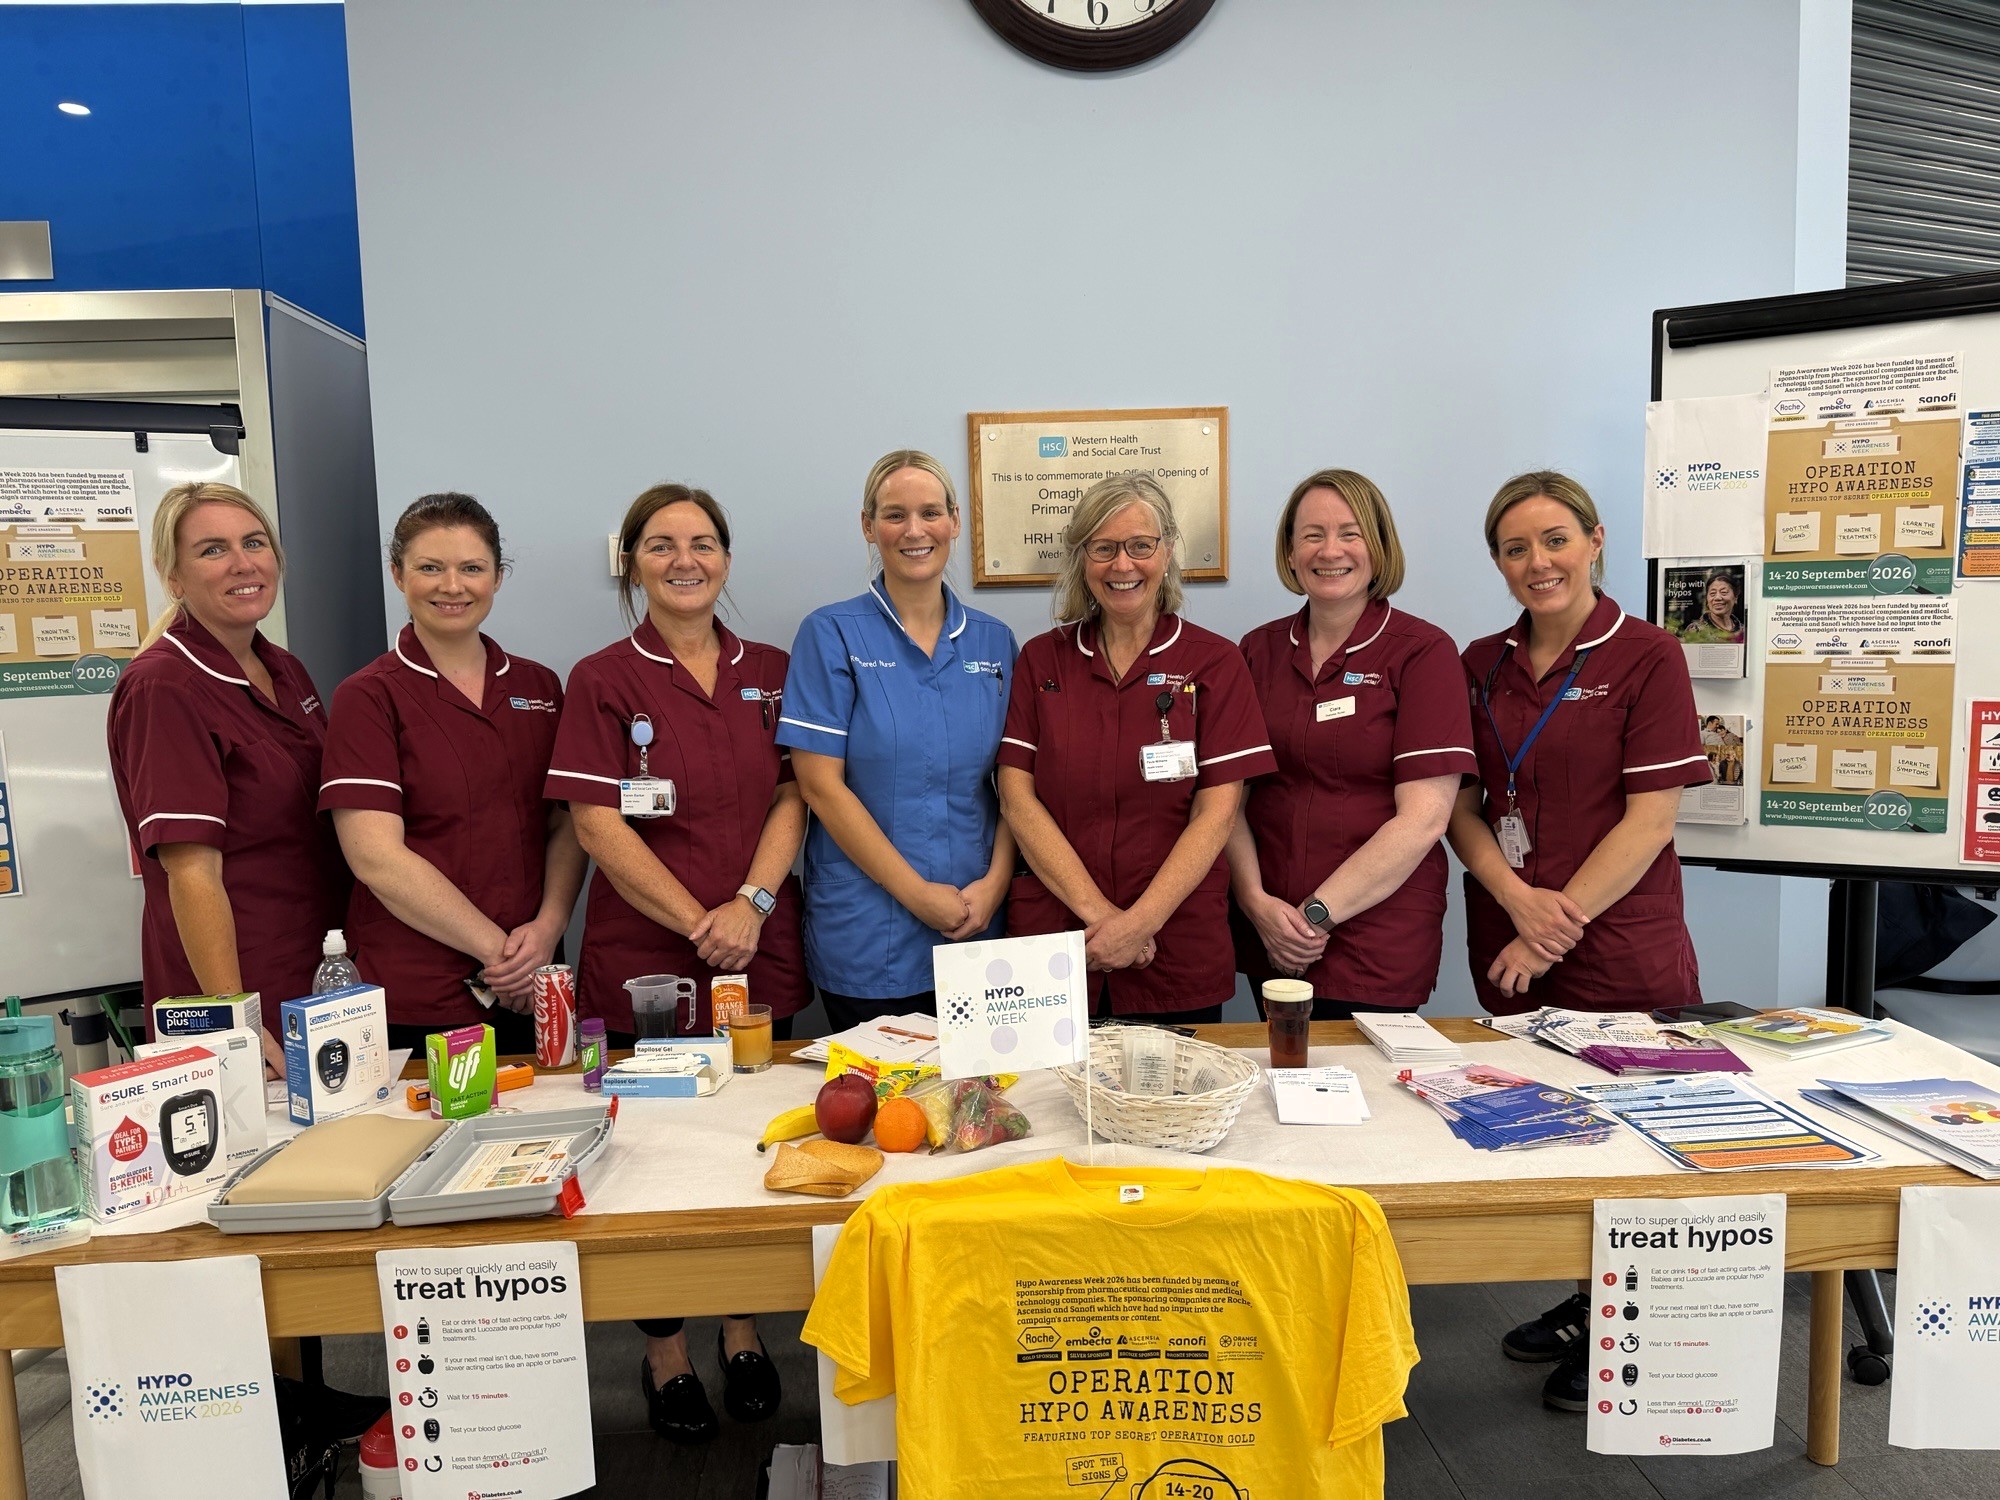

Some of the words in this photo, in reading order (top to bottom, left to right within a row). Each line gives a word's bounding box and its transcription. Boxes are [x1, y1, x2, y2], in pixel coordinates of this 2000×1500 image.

[1780, 403, 1800, 411] Roche
[1919, 393, 1956, 403] sanofi
[1072, 436, 1107, 445] Western
[1110, 435, 1138, 443] Health
[1042, 443, 1063, 452] HSC
[1073, 449, 1088, 457] and
[1092, 447, 1116, 456] Social
[1119, 447, 1138, 456] Care
[1141, 446, 1161, 455] Trust
[1687, 462, 1721, 472] HYPO
[1805, 460, 1916, 479] OPERATION
[992, 473, 1012, 482] This
[1014, 472, 1022, 482] is
[1025, 472, 1034, 481] to
[1037, 470, 1102, 481] commemorate
[1106, 470, 1120, 479] the
[1157, 467, 1197, 479] Opening
[1200, 467, 1209, 476] of
[1687, 469, 1760, 482] AWARENESS
[1687, 482, 1721, 491] WEEK
[1722, 480, 1747, 490] 2026
[1788, 482, 1829, 494] HYPO
[1835, 477, 1933, 492] AWARENESS
[1039, 487, 1083, 501] Omagh
[1790, 494, 1827, 502] FEATURING
[97, 507, 132, 515] sanofi
[1024, 533, 1052, 544] HRH
[1901, 528, 1934, 536] SYMPTOMS
[1769, 570, 1799, 580] 14-20
[1802, 569, 1867, 582] September
[1872, 567, 1912, 580] 2026
[26, 582, 123, 595] AWARENESS
[1668, 580, 1687, 590] Help
[1689, 579, 1706, 589] with
[1768, 583, 1868, 591] www.hypoawarenessweek.com
[1668, 588, 1692, 598] hypos
[1914, 638, 1951, 647] sanofi
[879, 660, 896, 668] Nurse
[3, 670, 71, 683] September
[77, 667, 116, 680] 2026
[1802, 700, 1911, 714] OPERATION
[1785, 716, 1825, 727] HYPO
[1831, 717, 1928, 729] AWARENESS
[1767, 800, 1796, 809] 14-20
[1799, 801, 1863, 813] September
[1868, 804, 1907, 816] 2026
[1765, 813, 1864, 823] www.hypoawarenessweek.com
[985, 986, 1024, 1000] HYPO
[343, 1003, 372, 1017] Nexus
[715, 1001, 743, 1010] ORANGE
[986, 994, 1067, 1013] AWARENESS
[166, 1010, 208, 1018] Contour
[987, 1012, 1028, 1026] WEEK
[166, 1018, 189, 1029] plus
[190, 1018, 210, 1028] BLUE
[152, 1074, 188, 1091] Smart
[192, 1068, 214, 1080] Duo
[450, 1095, 465, 1103] FAST
[466, 1090, 488, 1101] ACTING
[115, 1136, 136, 1148] TYPE
[115, 1143, 142, 1155] PATIENTS
[118, 1200, 140, 1210] NIPRO
[1610, 1215, 1633, 1225] how
[1635, 1215, 1646, 1225] to
[1648, 1216, 1678, 1226] super
[1681, 1214, 1715, 1226] quickly
[1717, 1213, 1736, 1223] and
[1739, 1212, 1766, 1223] easily
[1609, 1227, 1678, 1249] treat
[1688, 1226, 1773, 1252] hypos
[395, 1266, 418, 1276] how
[421, 1266, 431, 1275] to
[434, 1266, 463, 1277] super
[466, 1262, 502, 1276] quickly
[506, 1261, 525, 1272] and
[529, 1260, 557, 1271] easily
[394, 1277, 465, 1300] treat
[475, 1275, 566, 1302] hypos
[1016, 1280, 1037, 1288] Hypo
[1038, 1279, 1082, 1287] Awareness
[1143, 1276, 1160, 1284] been
[1192, 1277, 1201, 1286] by
[1016, 1287, 1064, 1298] sponsorship
[1088, 1286, 1150, 1295] pharmaceutical
[1212, 1287, 1242, 1296] medical
[1017, 1298, 1060, 1306] technology
[1062, 1296, 1106, 1305] companies.
[1124, 1296, 1167, 1304] sponsoring
[1169, 1296, 1211, 1304] companies
[1227, 1297, 1252, 1307] Roche,
[1017, 1306, 1051, 1315] Ascensia
[1070, 1305, 1095, 1313] Sanofi
[1143, 1304, 1158, 1312] had
[1017, 1316, 1061, 1325] campaign's
[1063, 1315, 1119, 1323] arrangements
[1025, 1333, 1054, 1344] Roche
[1066, 1336, 1111, 1346] embecta
[1169, 1336, 1206, 1346] sanofi
[137, 1373, 192, 1390] HYPO
[1049, 1369, 1234, 1395] OPERATION
[139, 1382, 260, 1406] AWARENESS
[140, 1406, 197, 1423] WEEK
[200, 1401, 243, 1419] 2026
[1020, 1401, 1089, 1423] HYPO
[1100, 1400, 1262, 1424] AWARENESS
[1024, 1431, 1086, 1442] FEATURING
[1091, 1430, 1111, 1440] TOP
[1115, 1431, 1157, 1441] SECRET
[1161, 1430, 1223, 1444] OPERATION
[1227, 1434, 1255, 1444] GOLD
[1072, 1459, 1095, 1471] SPOT
[1100, 1457, 1118, 1467] THE
[1082, 1470, 1111, 1480] SIGNS
[1166, 1482, 1213, 1500] 14-20
